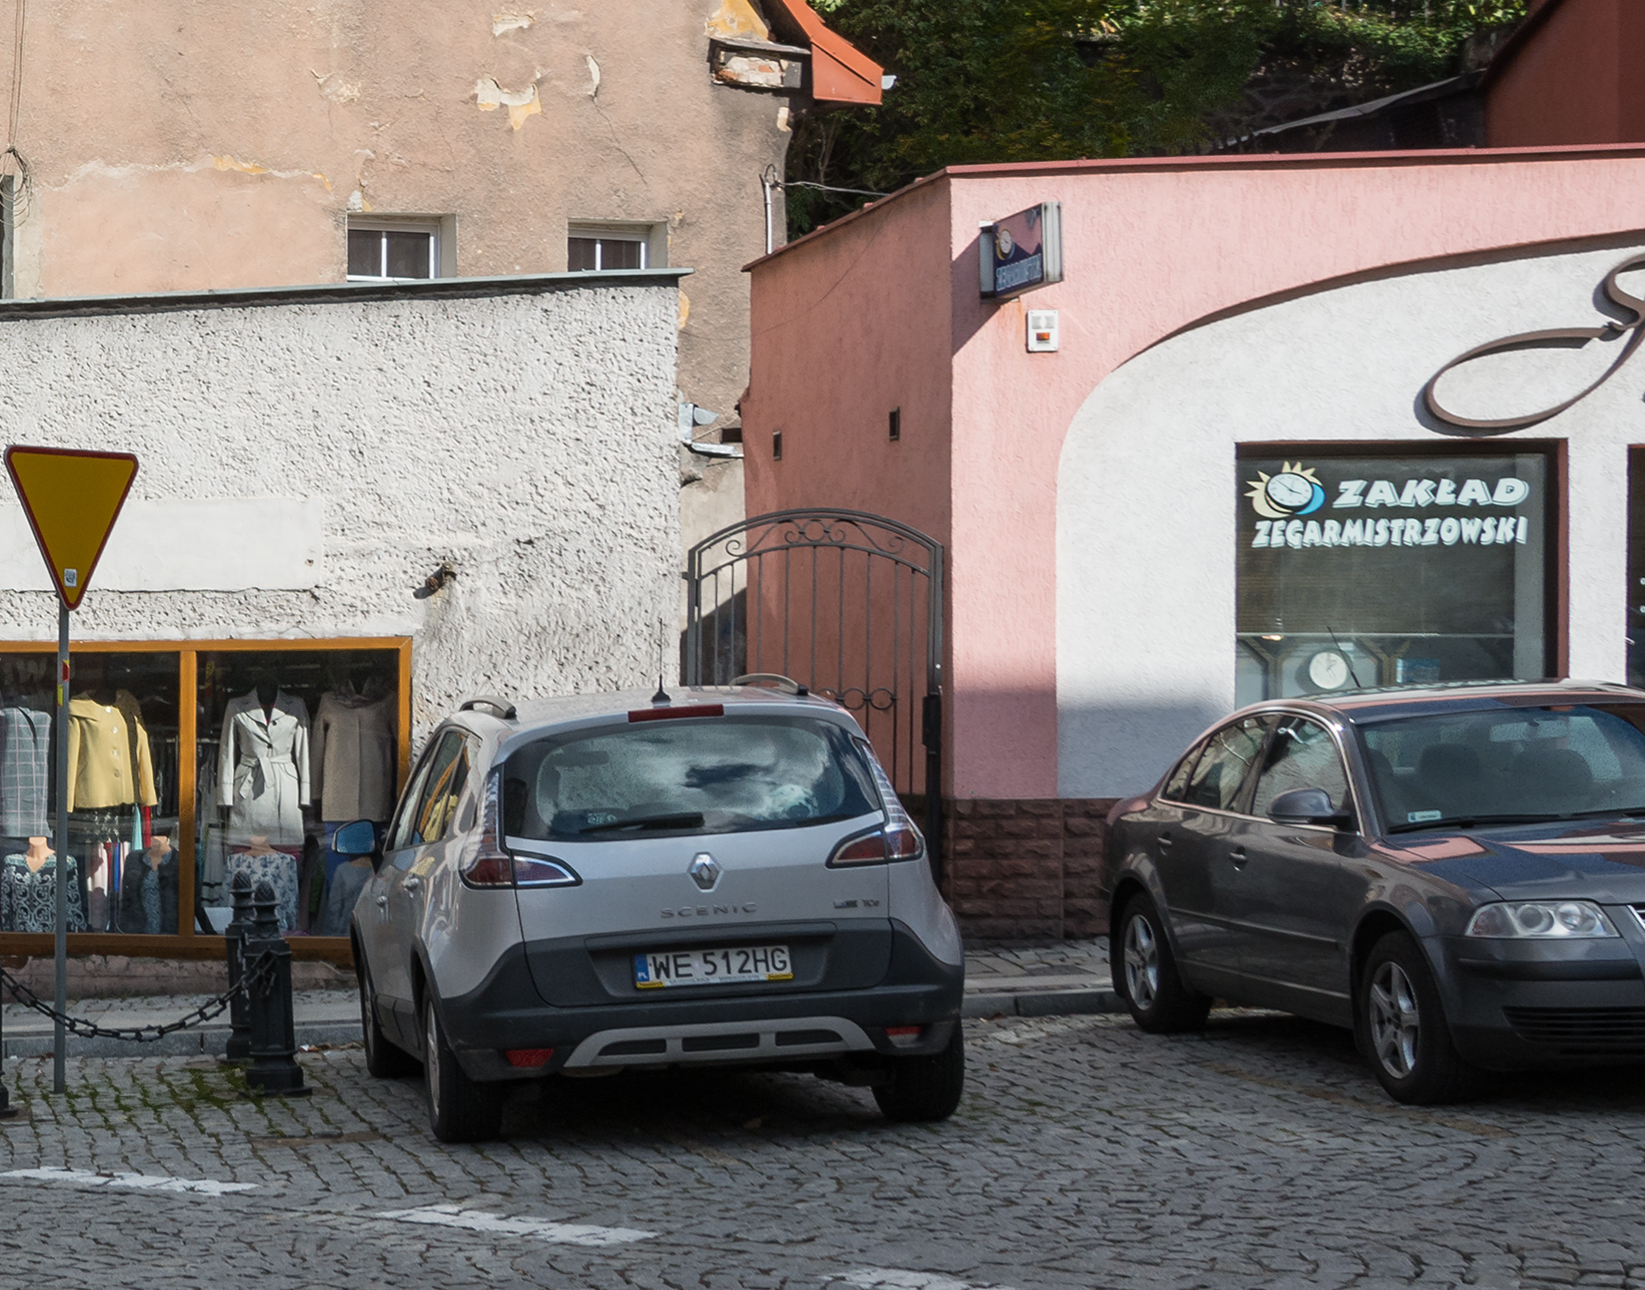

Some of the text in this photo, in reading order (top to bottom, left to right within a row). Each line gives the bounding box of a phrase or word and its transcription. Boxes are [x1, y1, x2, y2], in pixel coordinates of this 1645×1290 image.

[1332, 477, 1530, 508] ZAKŁAD
[1251, 515, 1528, 549] ZEGARMISTRZOWSKI
[660, 901, 757, 919] SCENIC
[652, 947, 788, 979] WE 512HG
